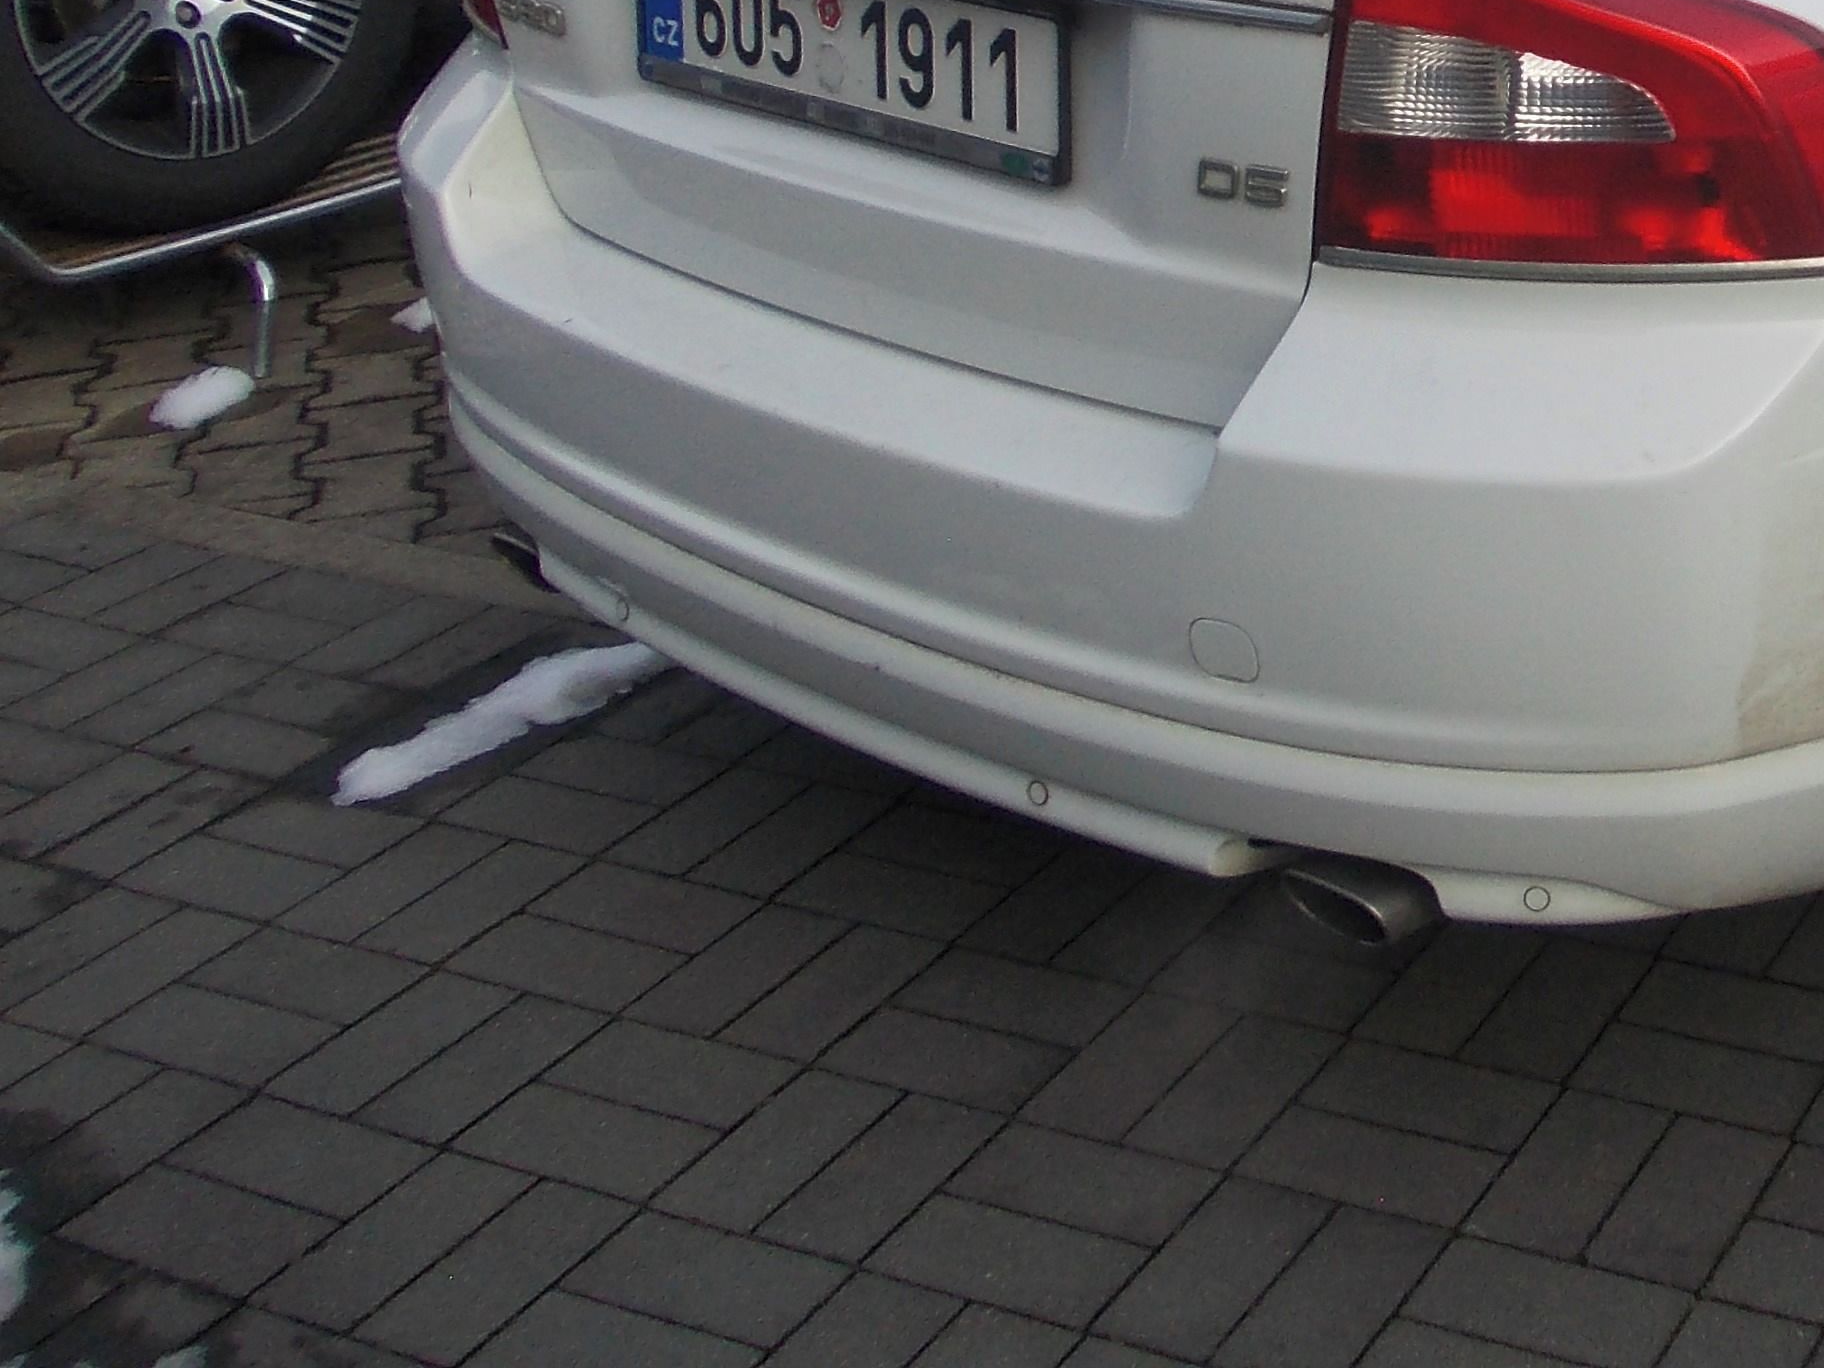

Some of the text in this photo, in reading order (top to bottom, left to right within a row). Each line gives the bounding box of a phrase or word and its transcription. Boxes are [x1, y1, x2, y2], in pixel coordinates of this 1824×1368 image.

[653, 16, 679, 46] CZ
[860, 0, 1019, 133] 1911
[1198, 159, 1289, 208] D5
